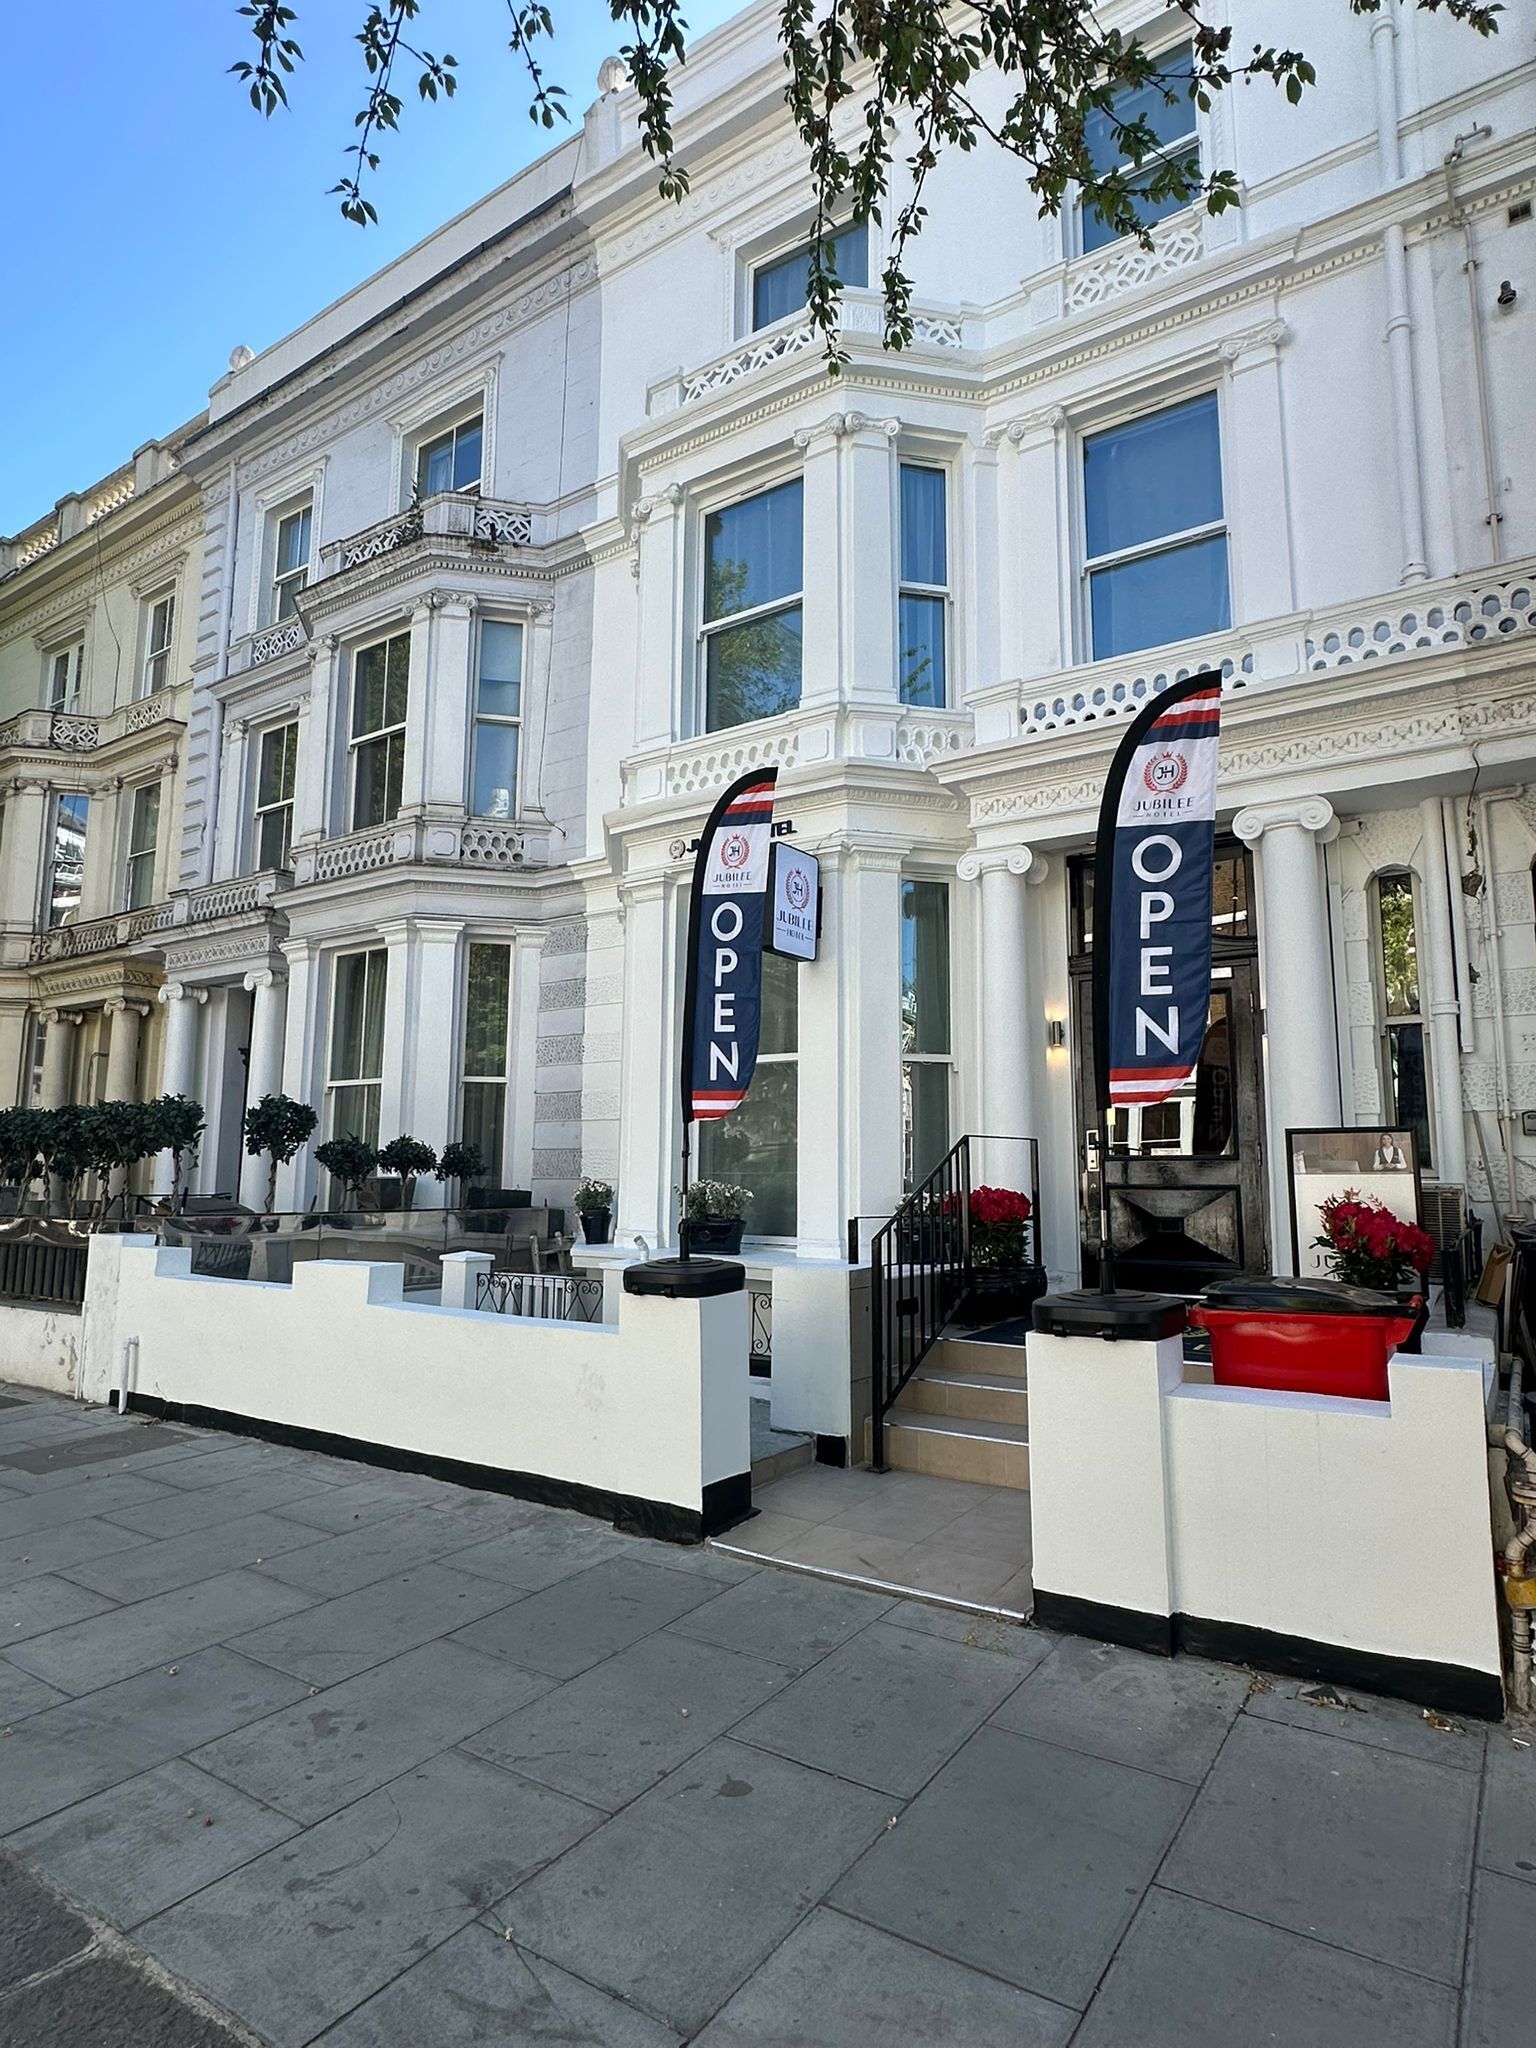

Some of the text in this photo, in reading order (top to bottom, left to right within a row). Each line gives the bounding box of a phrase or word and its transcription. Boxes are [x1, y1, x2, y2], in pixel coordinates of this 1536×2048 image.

[1133, 797, 1195, 811] JUBILEE
[770, 820, 797, 837] TEL
[713, 871, 752, 882] JUBILEE
[776, 910, 813, 931] JUBILEE
[1131, 834, 1183, 1056] OPEN
[709, 901, 743, 1081] OPEN
